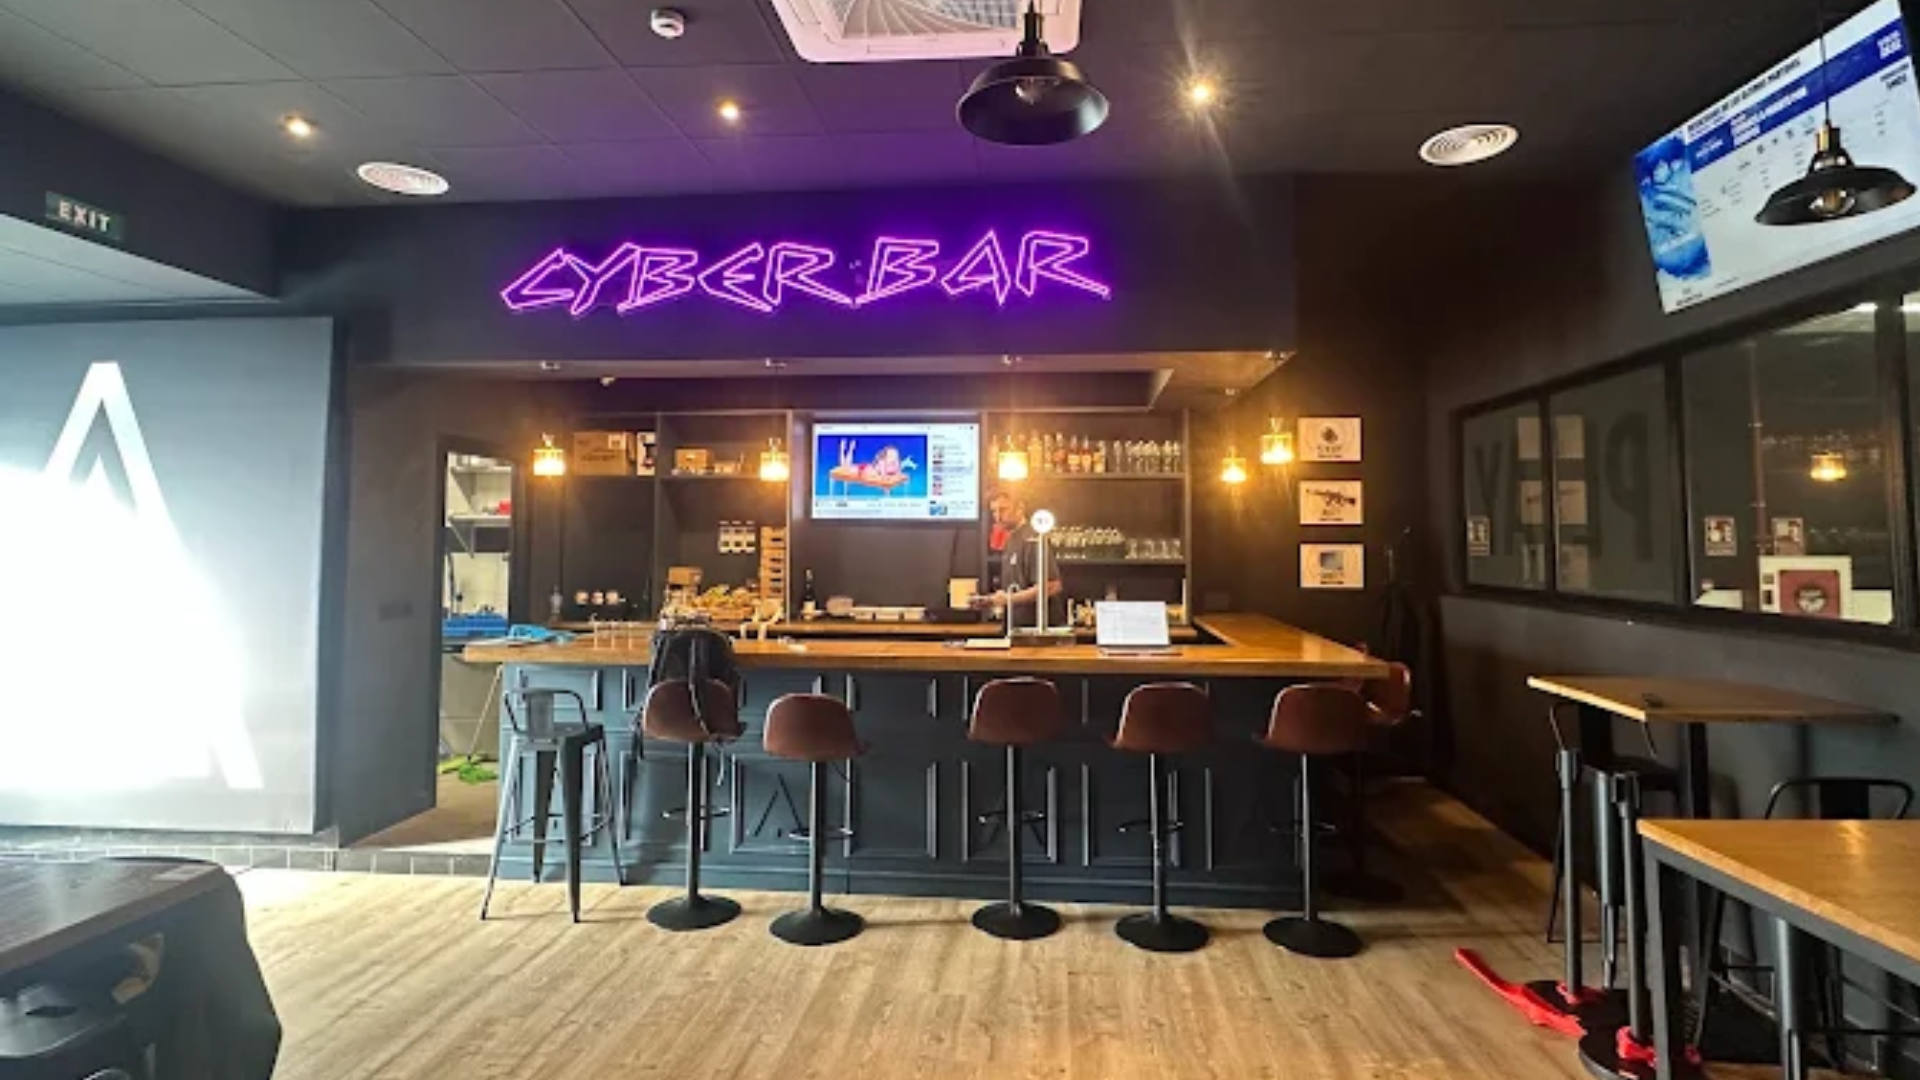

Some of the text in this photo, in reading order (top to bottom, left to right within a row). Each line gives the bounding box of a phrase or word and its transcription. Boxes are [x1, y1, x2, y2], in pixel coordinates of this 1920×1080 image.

[59, 200, 110, 232] EXIT
[500, 229, 1111, 315] CYBER BAR
